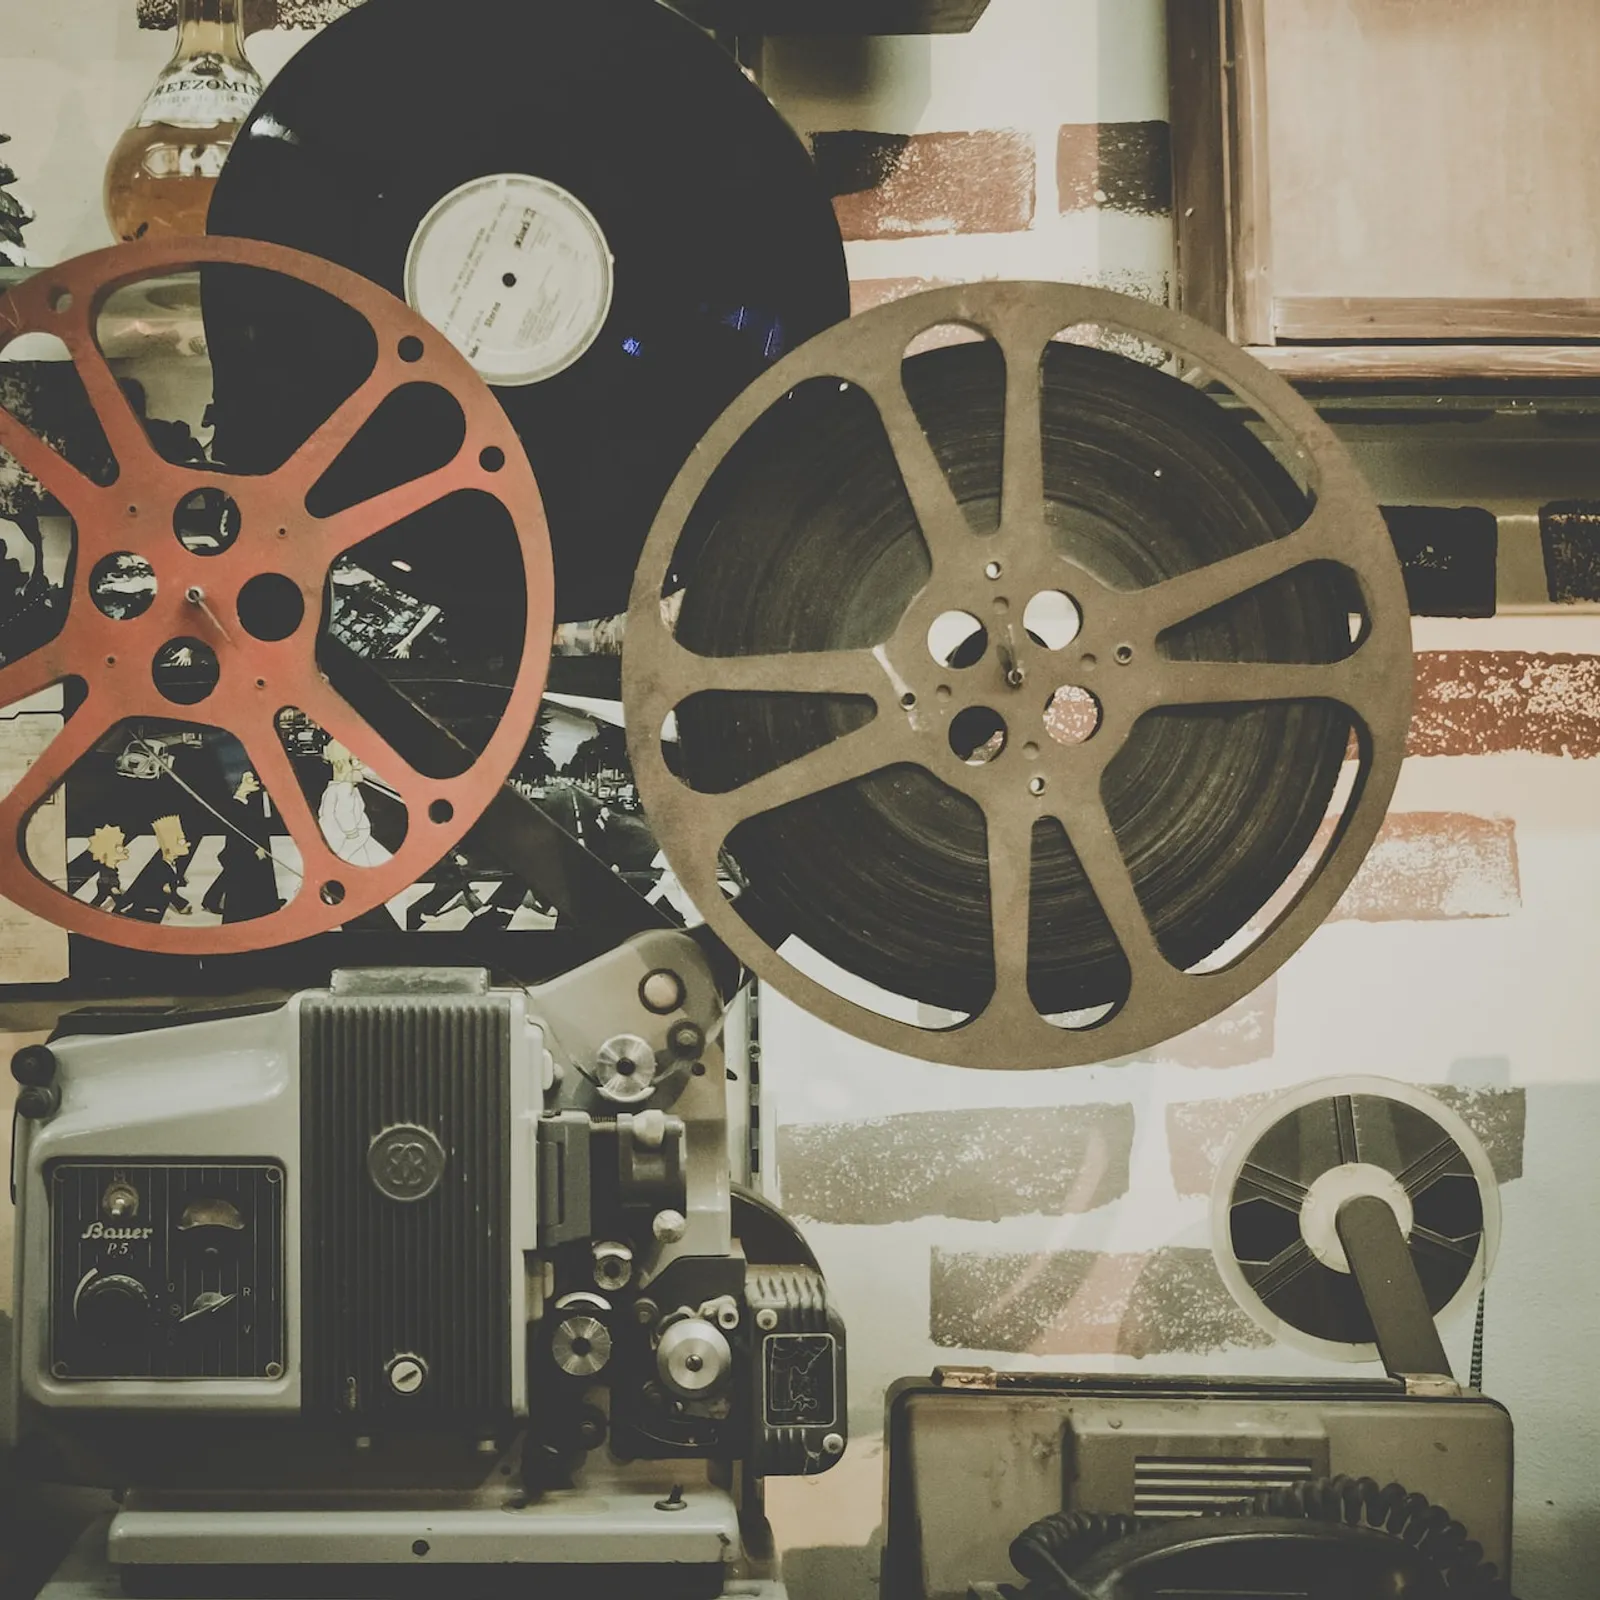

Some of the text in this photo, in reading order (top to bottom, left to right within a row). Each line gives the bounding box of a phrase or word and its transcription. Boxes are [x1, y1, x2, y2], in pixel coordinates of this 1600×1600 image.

[81, 1221, 153, 1239] Bauer
[107, 1242, 129, 1255] P 5
[242, 1287, 251, 1297] R
